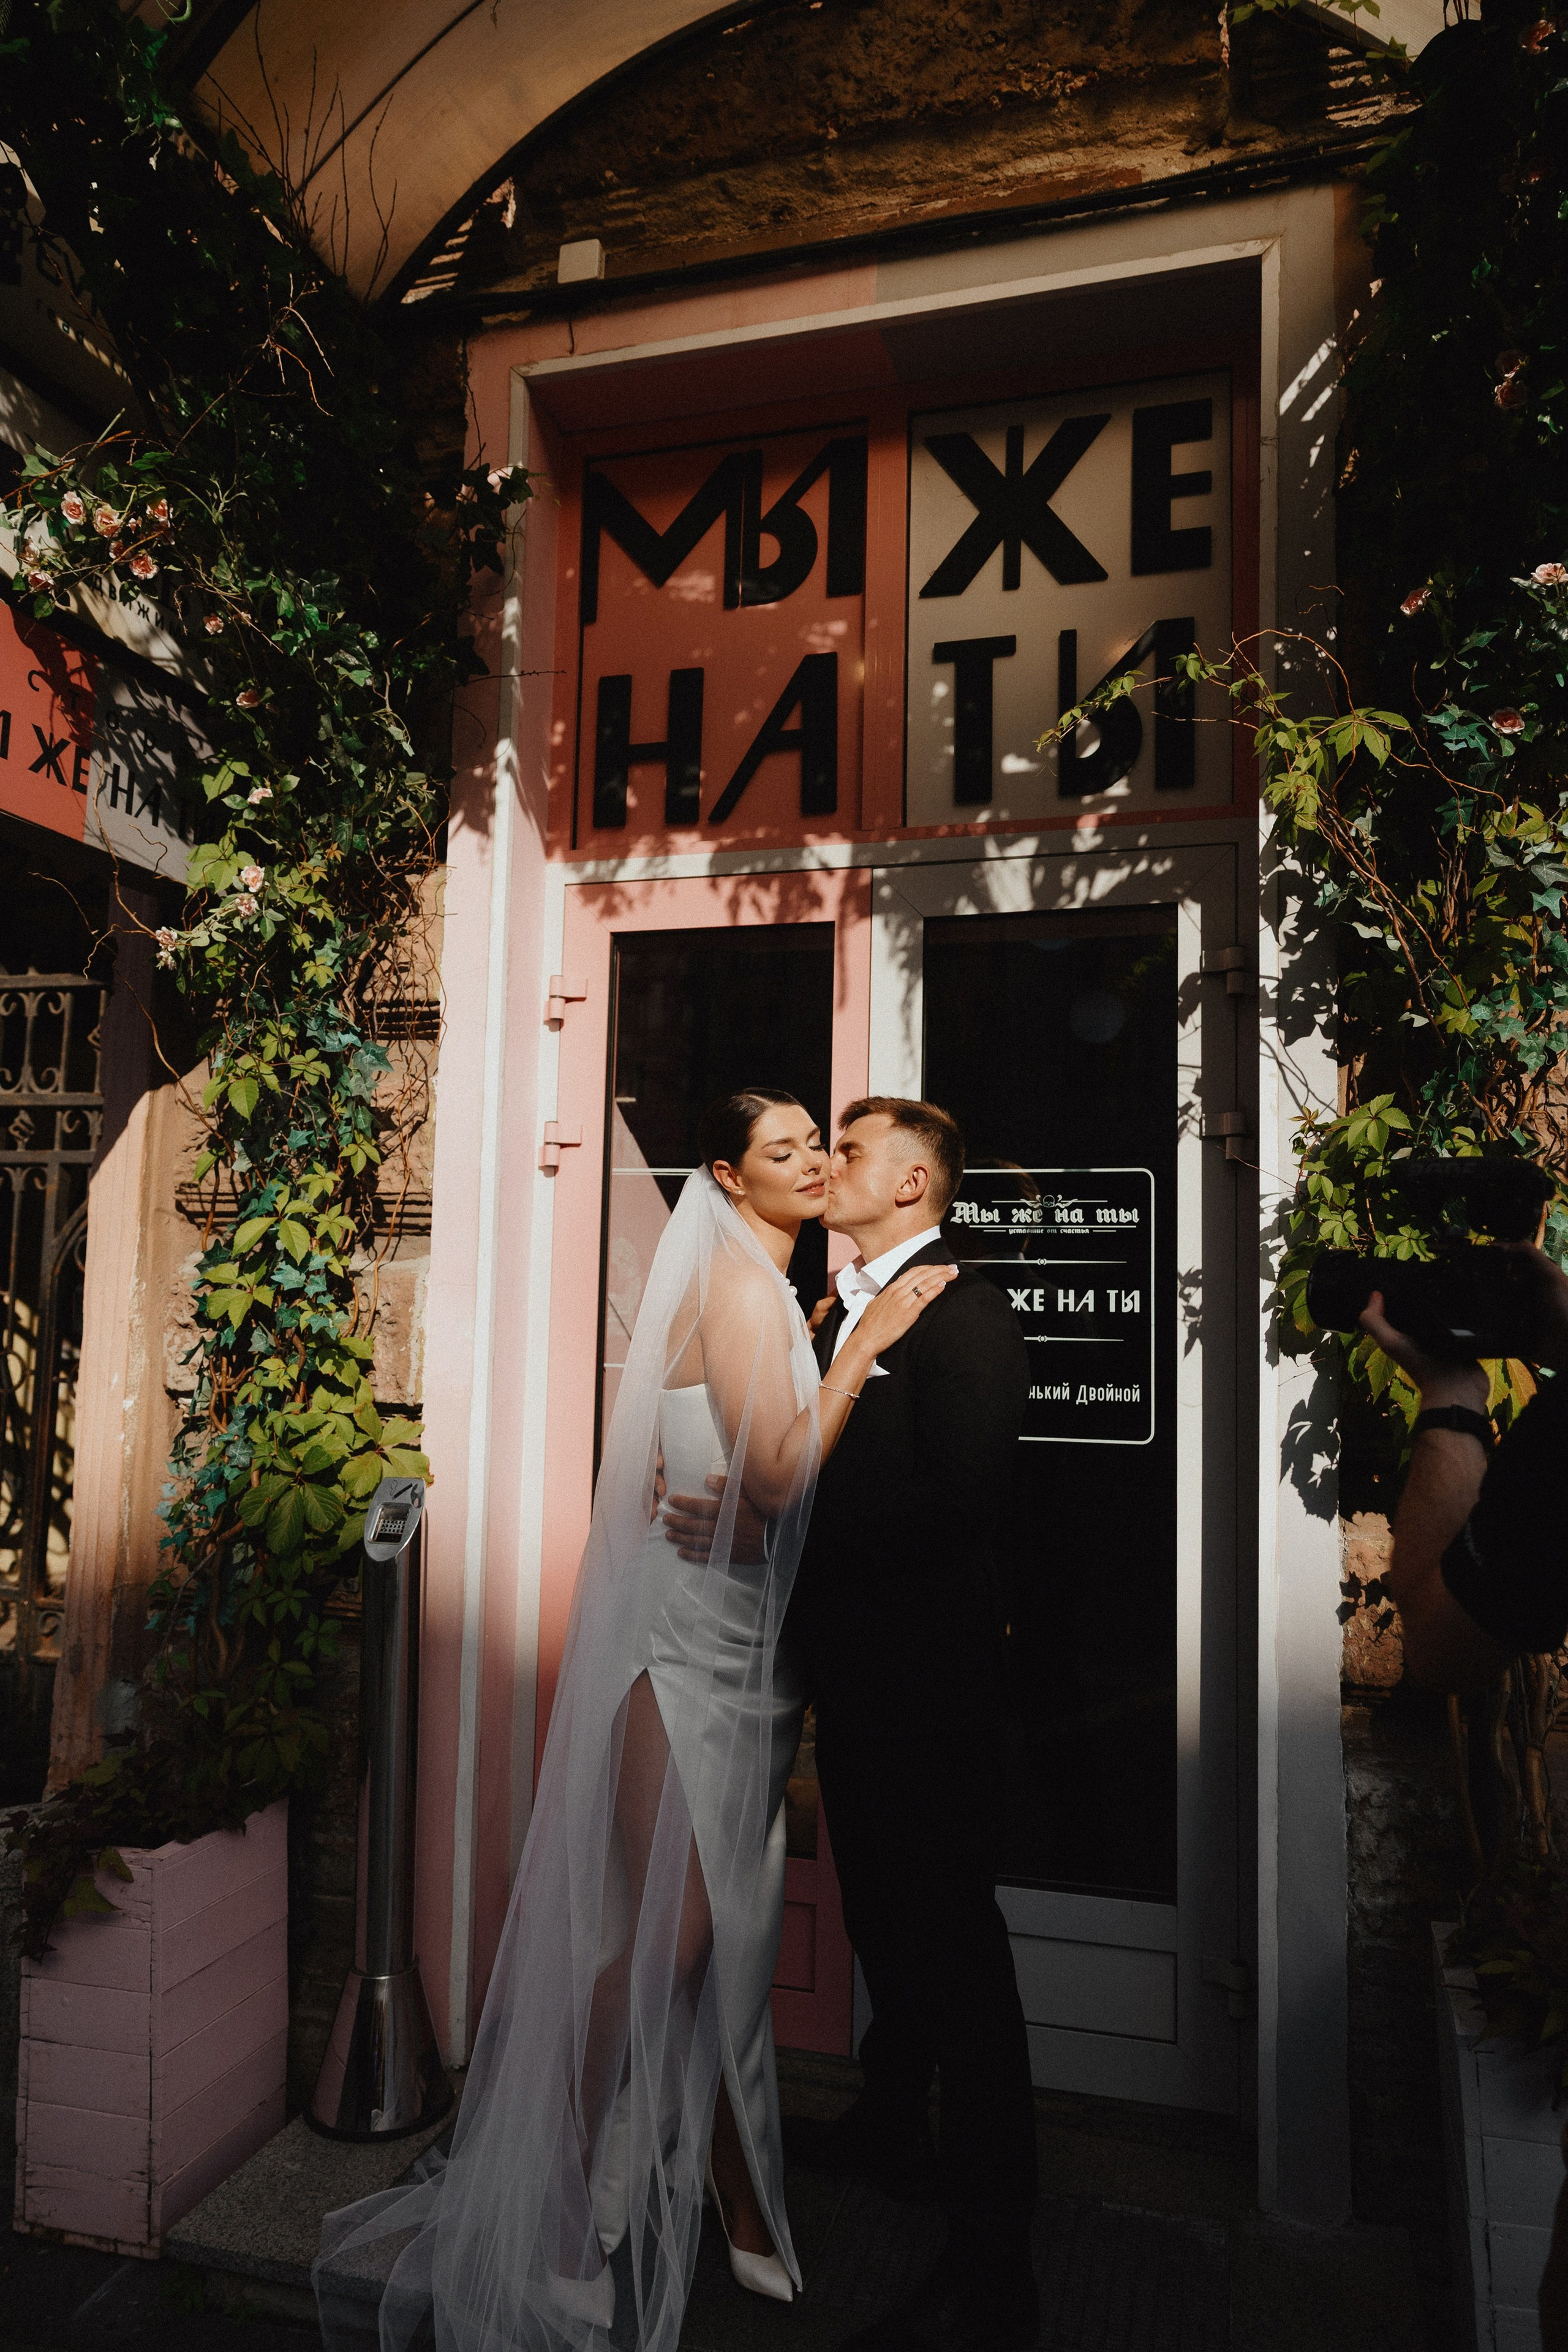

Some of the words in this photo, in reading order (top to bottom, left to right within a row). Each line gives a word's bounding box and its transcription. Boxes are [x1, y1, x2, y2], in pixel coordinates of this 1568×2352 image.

[581, 435, 869, 624] МЫ
[919, 398, 1213, 598] ЖЕ
[594, 652, 838, 829] НА
[932, 616, 1196, 807] ТЫ
[28, 723, 91, 796] ЖЕ
[110, 763, 161, 827] НА
[950, 1201, 1001, 1224] Мы
[1011, 1208, 1043, 1224] же
[1054, 1208, 1085, 1224] на
[1095, 1208, 1140, 1224] ты
[1006, 1288, 1045, 1312] ЖЕ
[1057, 1289, 1095, 1313] НА
[1106, 1289, 1140, 1313] ТЫ
[1028, 1382, 1070, 1400] нький
[1076, 1383, 1140, 1406] Двойной
